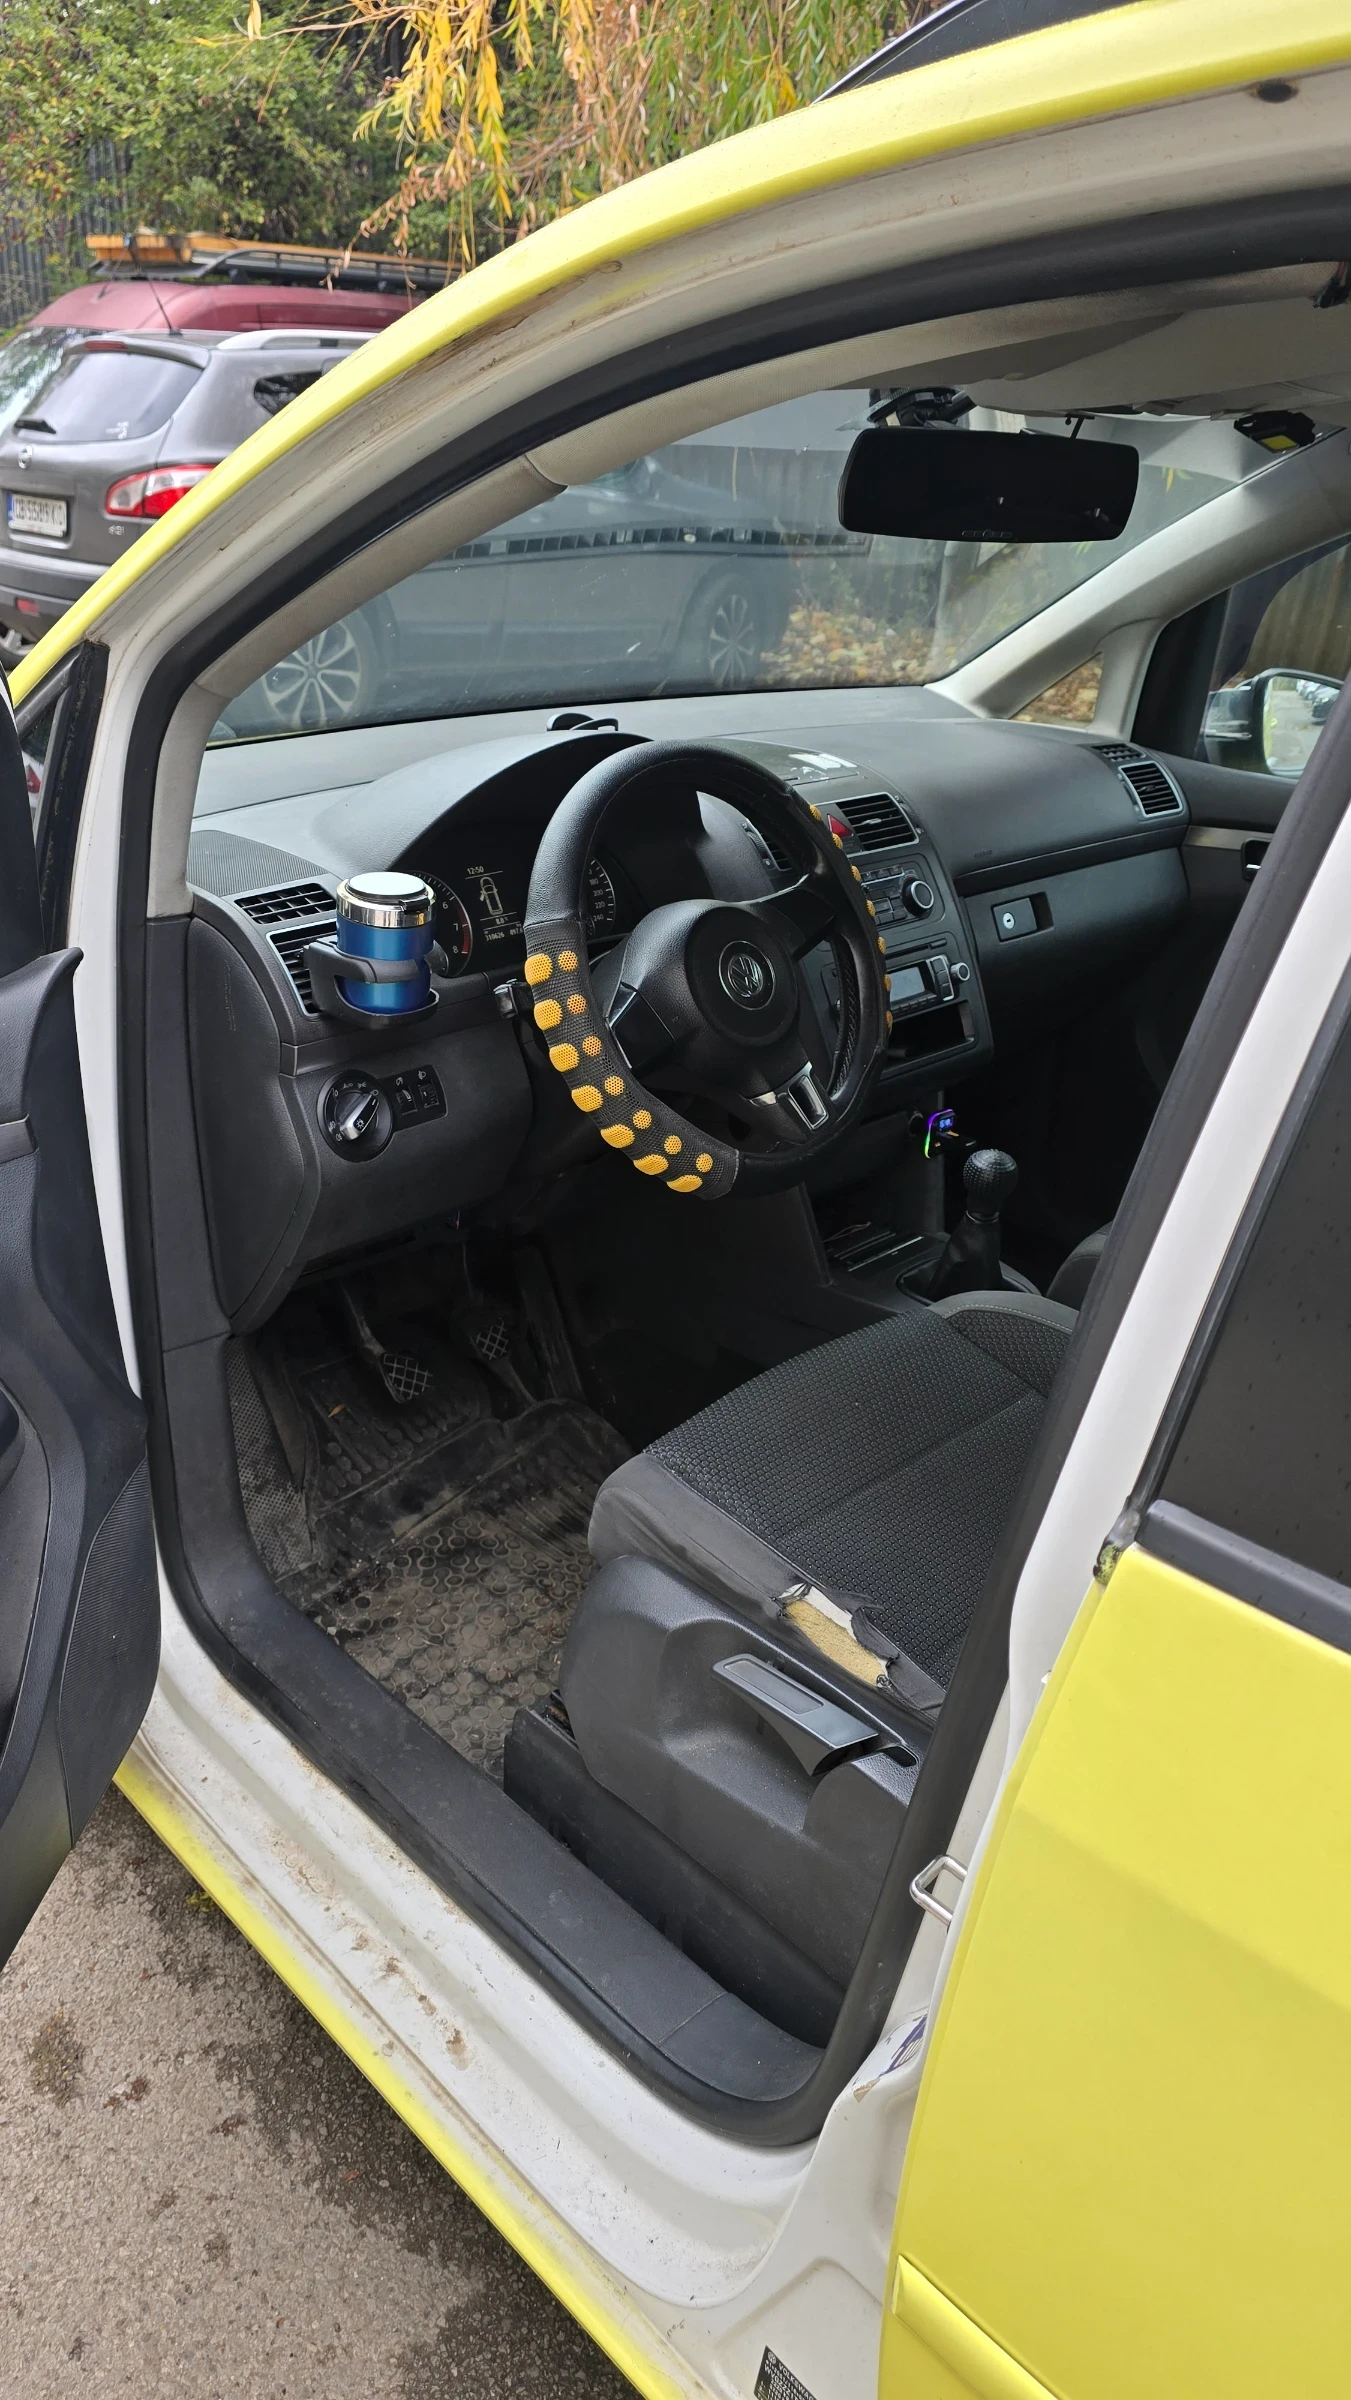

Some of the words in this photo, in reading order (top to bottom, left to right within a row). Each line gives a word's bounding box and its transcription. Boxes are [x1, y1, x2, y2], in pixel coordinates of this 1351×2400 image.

[442, 901, 449, 909] 6
[452, 923, 459, 931] 7
[452, 945, 459, 954] 8
